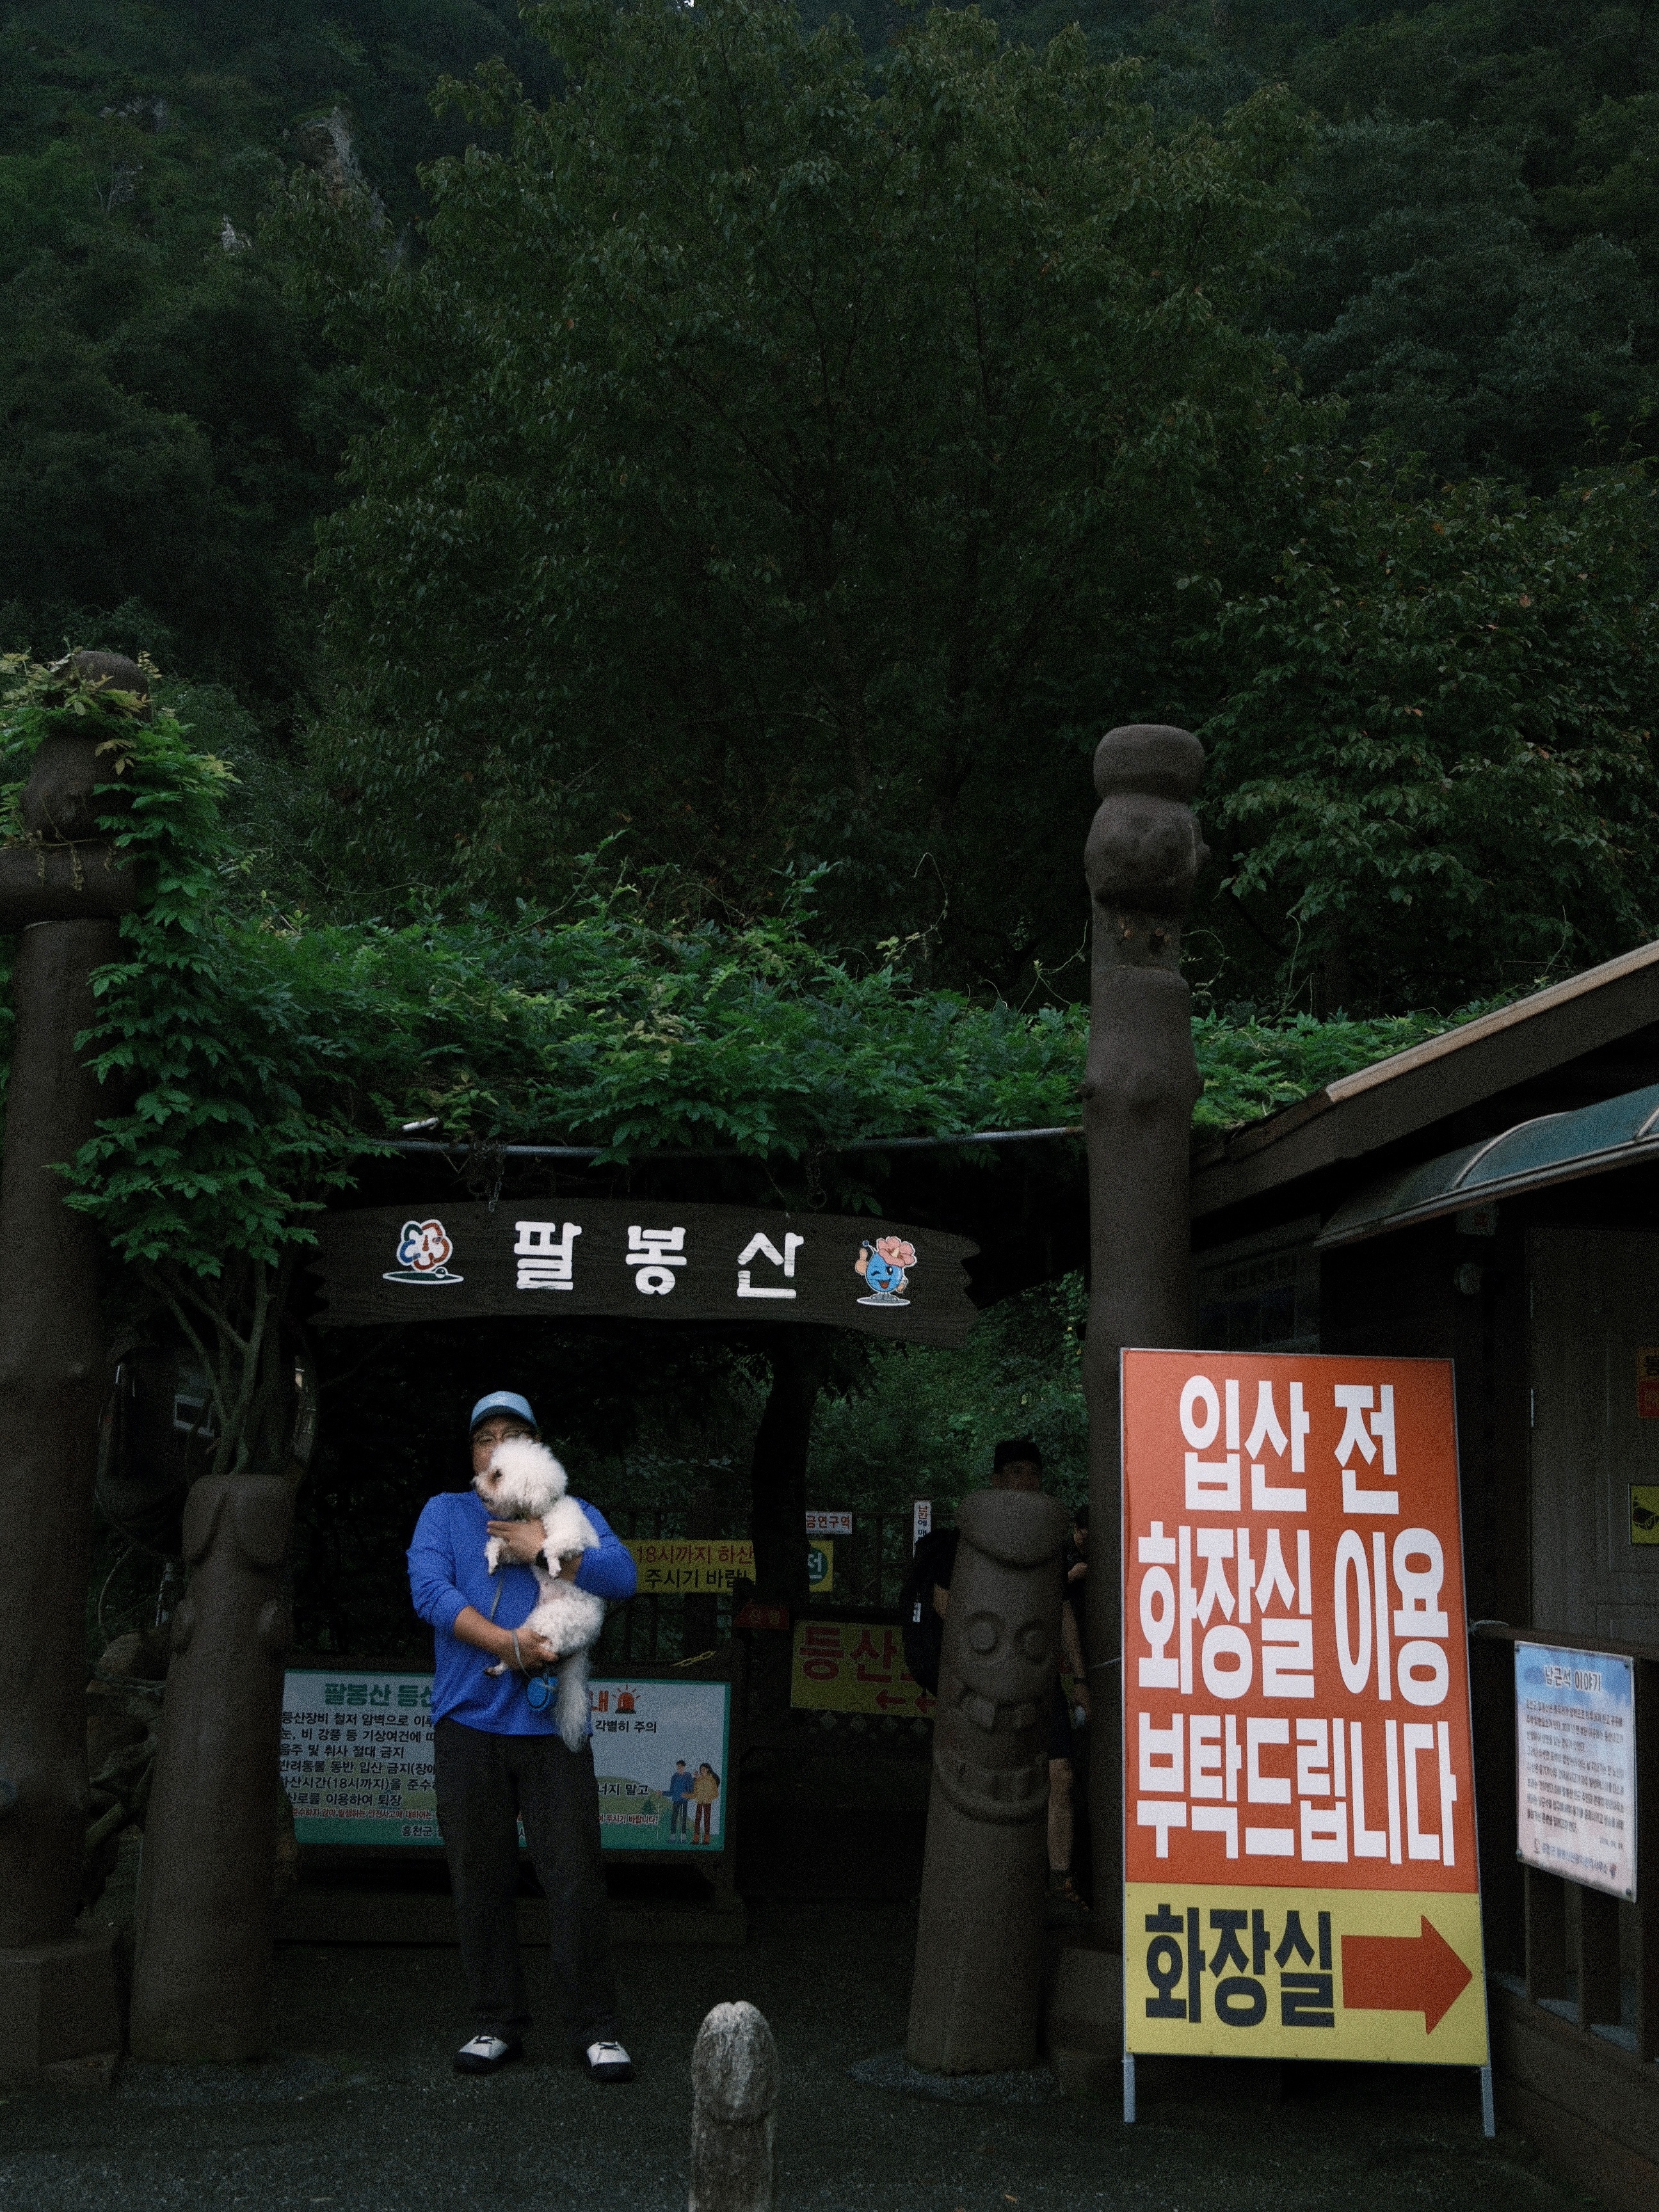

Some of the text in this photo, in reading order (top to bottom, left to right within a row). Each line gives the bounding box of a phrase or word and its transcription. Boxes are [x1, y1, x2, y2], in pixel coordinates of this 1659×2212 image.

[514, 1221, 804, 1298] 팔봉산
[1179, 1375, 1399, 1514] 입산 전
[806, 1515, 851, 1529] 금연구역
[637, 1545, 712, 1564] 18시까지
[645, 1569, 748, 1588] 주시기 바랍
[1138, 1521, 1450, 1706] 화장실 이용
[800, 1626, 917, 1683] 등산
[1544, 1666, 1601, 1692] 남근석 이야기
[325, 1683, 391, 1706] 팔봉산
[282, 1711, 328, 1725] 등산장비
[334, 1713, 358, 1726] 철저
[362, 1713, 410, 1727] 암벽으로
[595, 1720, 629, 1733] 각별히
[634, 1721, 657, 1733] 주의
[301, 1728, 313, 1740] 비
[319, 1728, 341, 1742] 강풍
[346, 1730, 357, 1742] 등
[363, 1730, 422, 1743] 기상여건에
[280, 1743, 405, 1759] 음주 및 취사 절대 금지
[330, 1761, 355, 1774] 동반
[360, 1761, 382, 1775] 입산
[407, 1778, 436, 1791] 준수
[625, 1784, 649, 1796] 말고
[1137, 1712, 1458, 1866] 부탁드립니다
[326, 1793, 373, 1806] 이용하여
[378, 1794, 402, 1807] 퇴장
[606, 1814, 626, 1823] 주시기
[401, 1825, 433, 1838] 홍천군
[1144, 1903, 1335, 2028] 화장실
